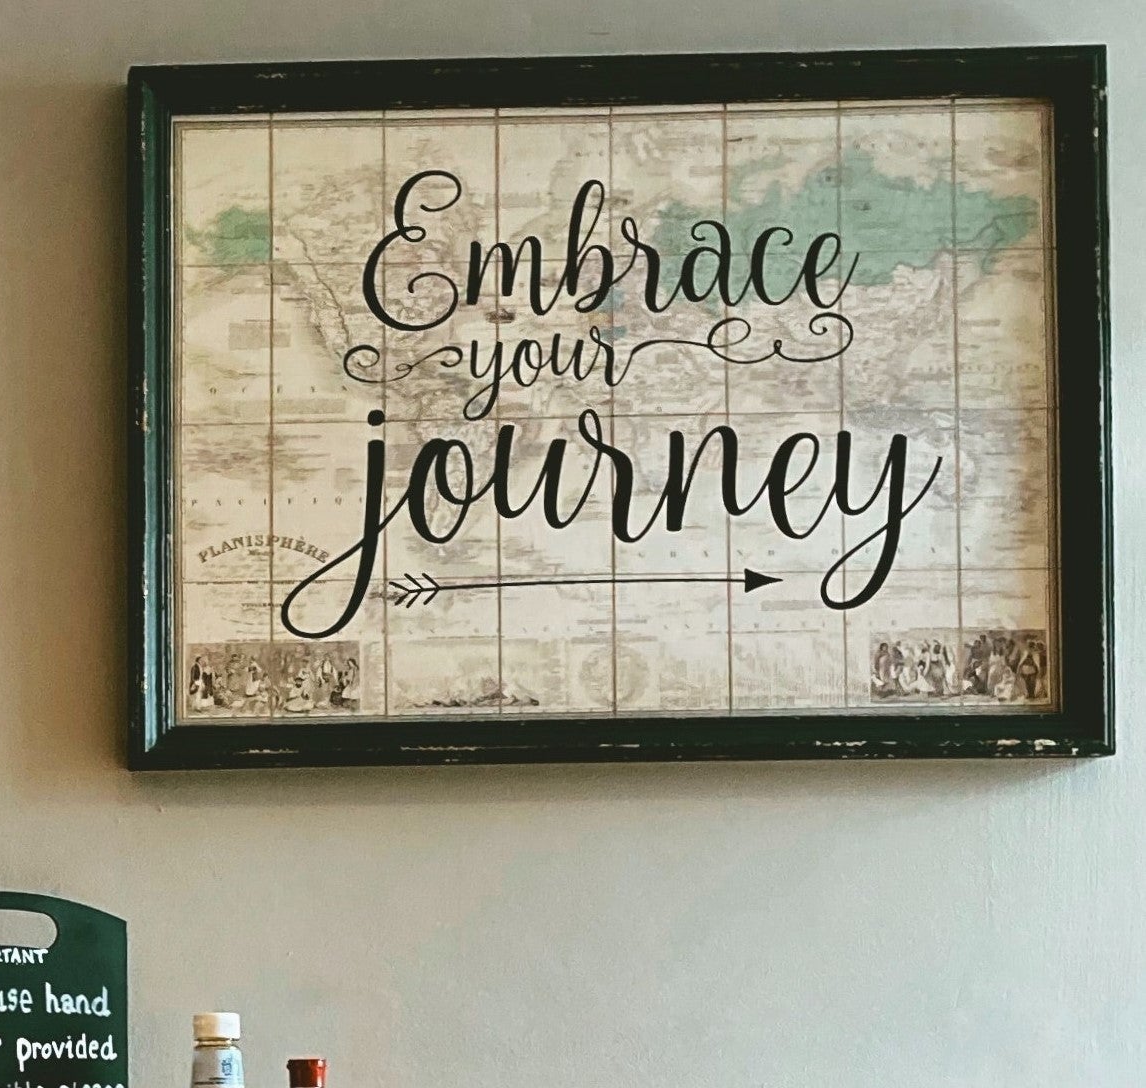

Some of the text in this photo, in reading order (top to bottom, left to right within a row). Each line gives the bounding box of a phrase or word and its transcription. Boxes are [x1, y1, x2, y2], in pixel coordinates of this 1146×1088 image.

[362, 170, 858, 332] Embrace
[281, 408, 942, 639] journey
[198, 535, 330, 564] PLANISPHÈRE
[45, 981, 112, 1018] hand
[16, 1033, 118, 1073] provided
